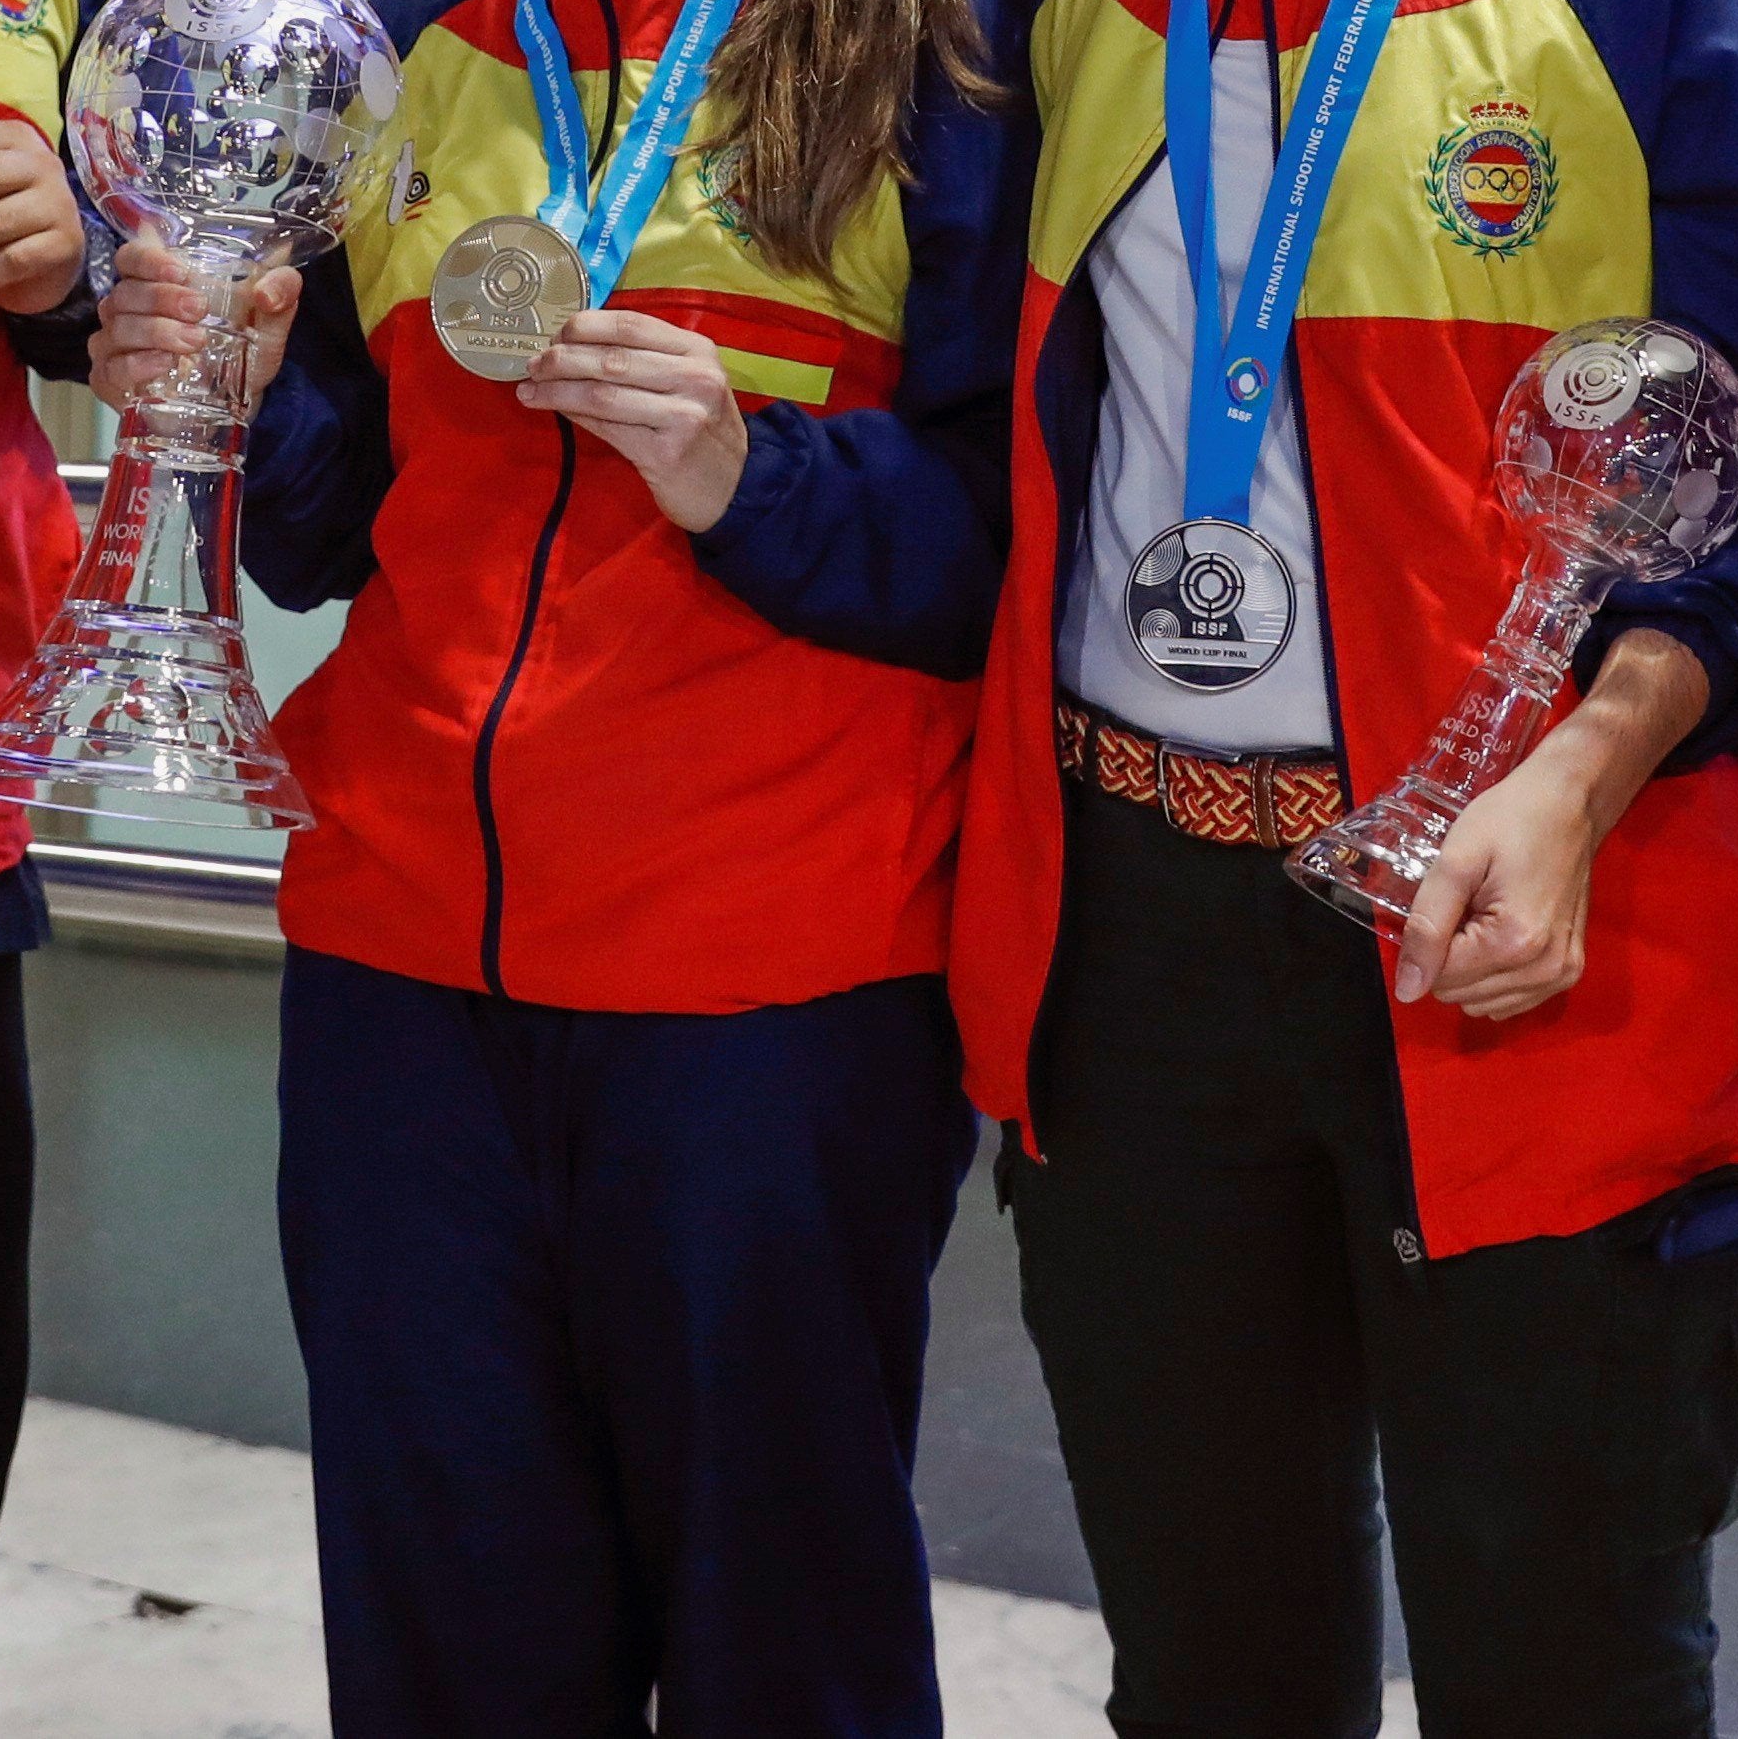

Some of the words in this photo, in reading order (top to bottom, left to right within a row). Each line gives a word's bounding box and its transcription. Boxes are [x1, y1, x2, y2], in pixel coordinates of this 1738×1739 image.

[186, 21, 242, 35] ISSF
[589, 169, 642, 267] INTERNATIONAL
[633, 105, 671, 171] SHOOTING
[662, 60, 689, 105] SPORT
[1256, 211, 1300, 330] INTERNATIONAL
[1289, 127, 1325, 208] SHOOTING
[1314, 76, 1343, 126] SPORT
[489, 313, 522, 329] ISSF
[1226, 406, 1253, 423] ISSF
[1555, 402, 1601, 424] ISSF
[1192, 620, 1229, 637] ISSF
[1167, 645, 1200, 657] WORLD
[1203, 647, 1222, 659] CUP
[1222, 649, 1249, 660] FINAL
[1459, 747, 1497, 773] 2017
